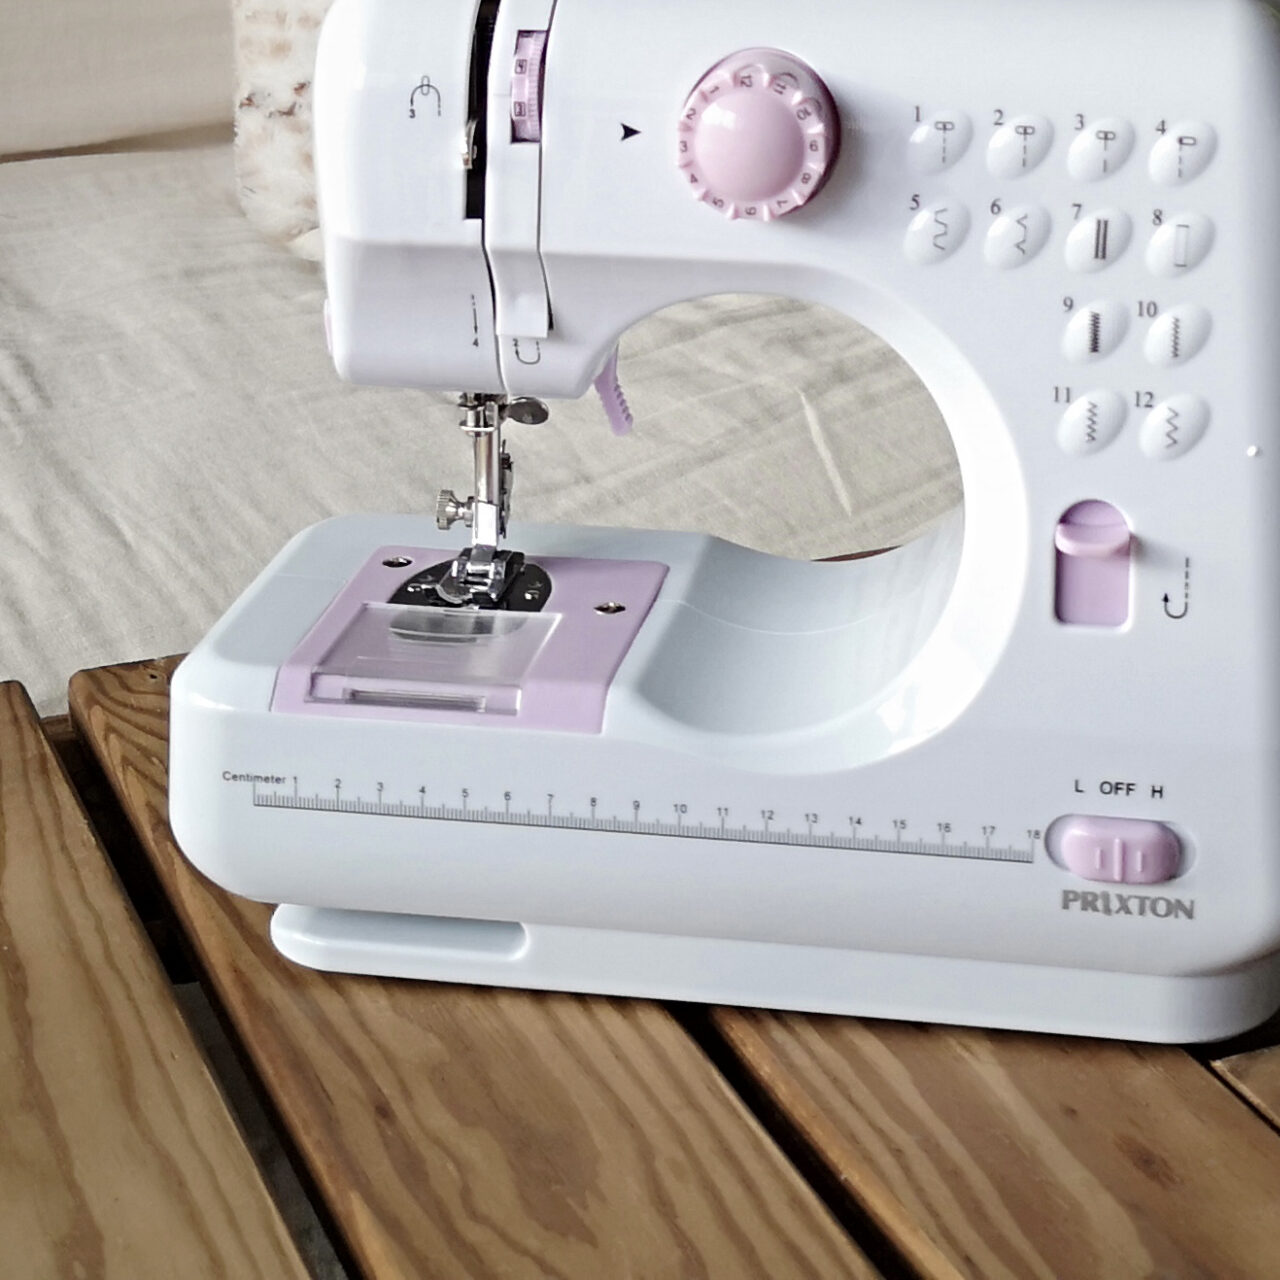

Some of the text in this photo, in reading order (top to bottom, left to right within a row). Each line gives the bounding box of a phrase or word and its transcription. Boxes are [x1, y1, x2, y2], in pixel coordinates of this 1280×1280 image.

[686, 108, 697, 120] 2
[914, 106, 1166, 135] 1 2 3 4
[679, 140, 688, 153] 3
[689, 174, 699, 184] 4
[801, 173, 812, 184] 8
[712, 197, 725, 208] 5
[909, 194, 1163, 226] 5 6 7 8
[1063, 296, 1158, 318] 9 10
[1053, 386, 1154, 408] 11 12
[1074, 779, 1164, 799] L OFF H
[222, 771, 286, 784] Centimeter
[334, 778, 341, 789] 2
[376, 782, 384, 791] 3
[419, 785, 426, 794] 4
[462, 788, 469, 798] 5
[504, 791, 511, 801] 6
[590, 797, 597, 807] 8
[633, 800, 640, 811] 9
[673, 804, 687, 814] 10
[717, 807, 729, 816] 11
[761, 810, 774, 820] 12
[804, 813, 818, 823] 13
[849, 816, 862, 825] 14
[893, 819, 906, 829] 15
[937, 822, 951, 833] 16
[981, 825, 995, 835] 17
[1027, 829, 1040, 839] 18
